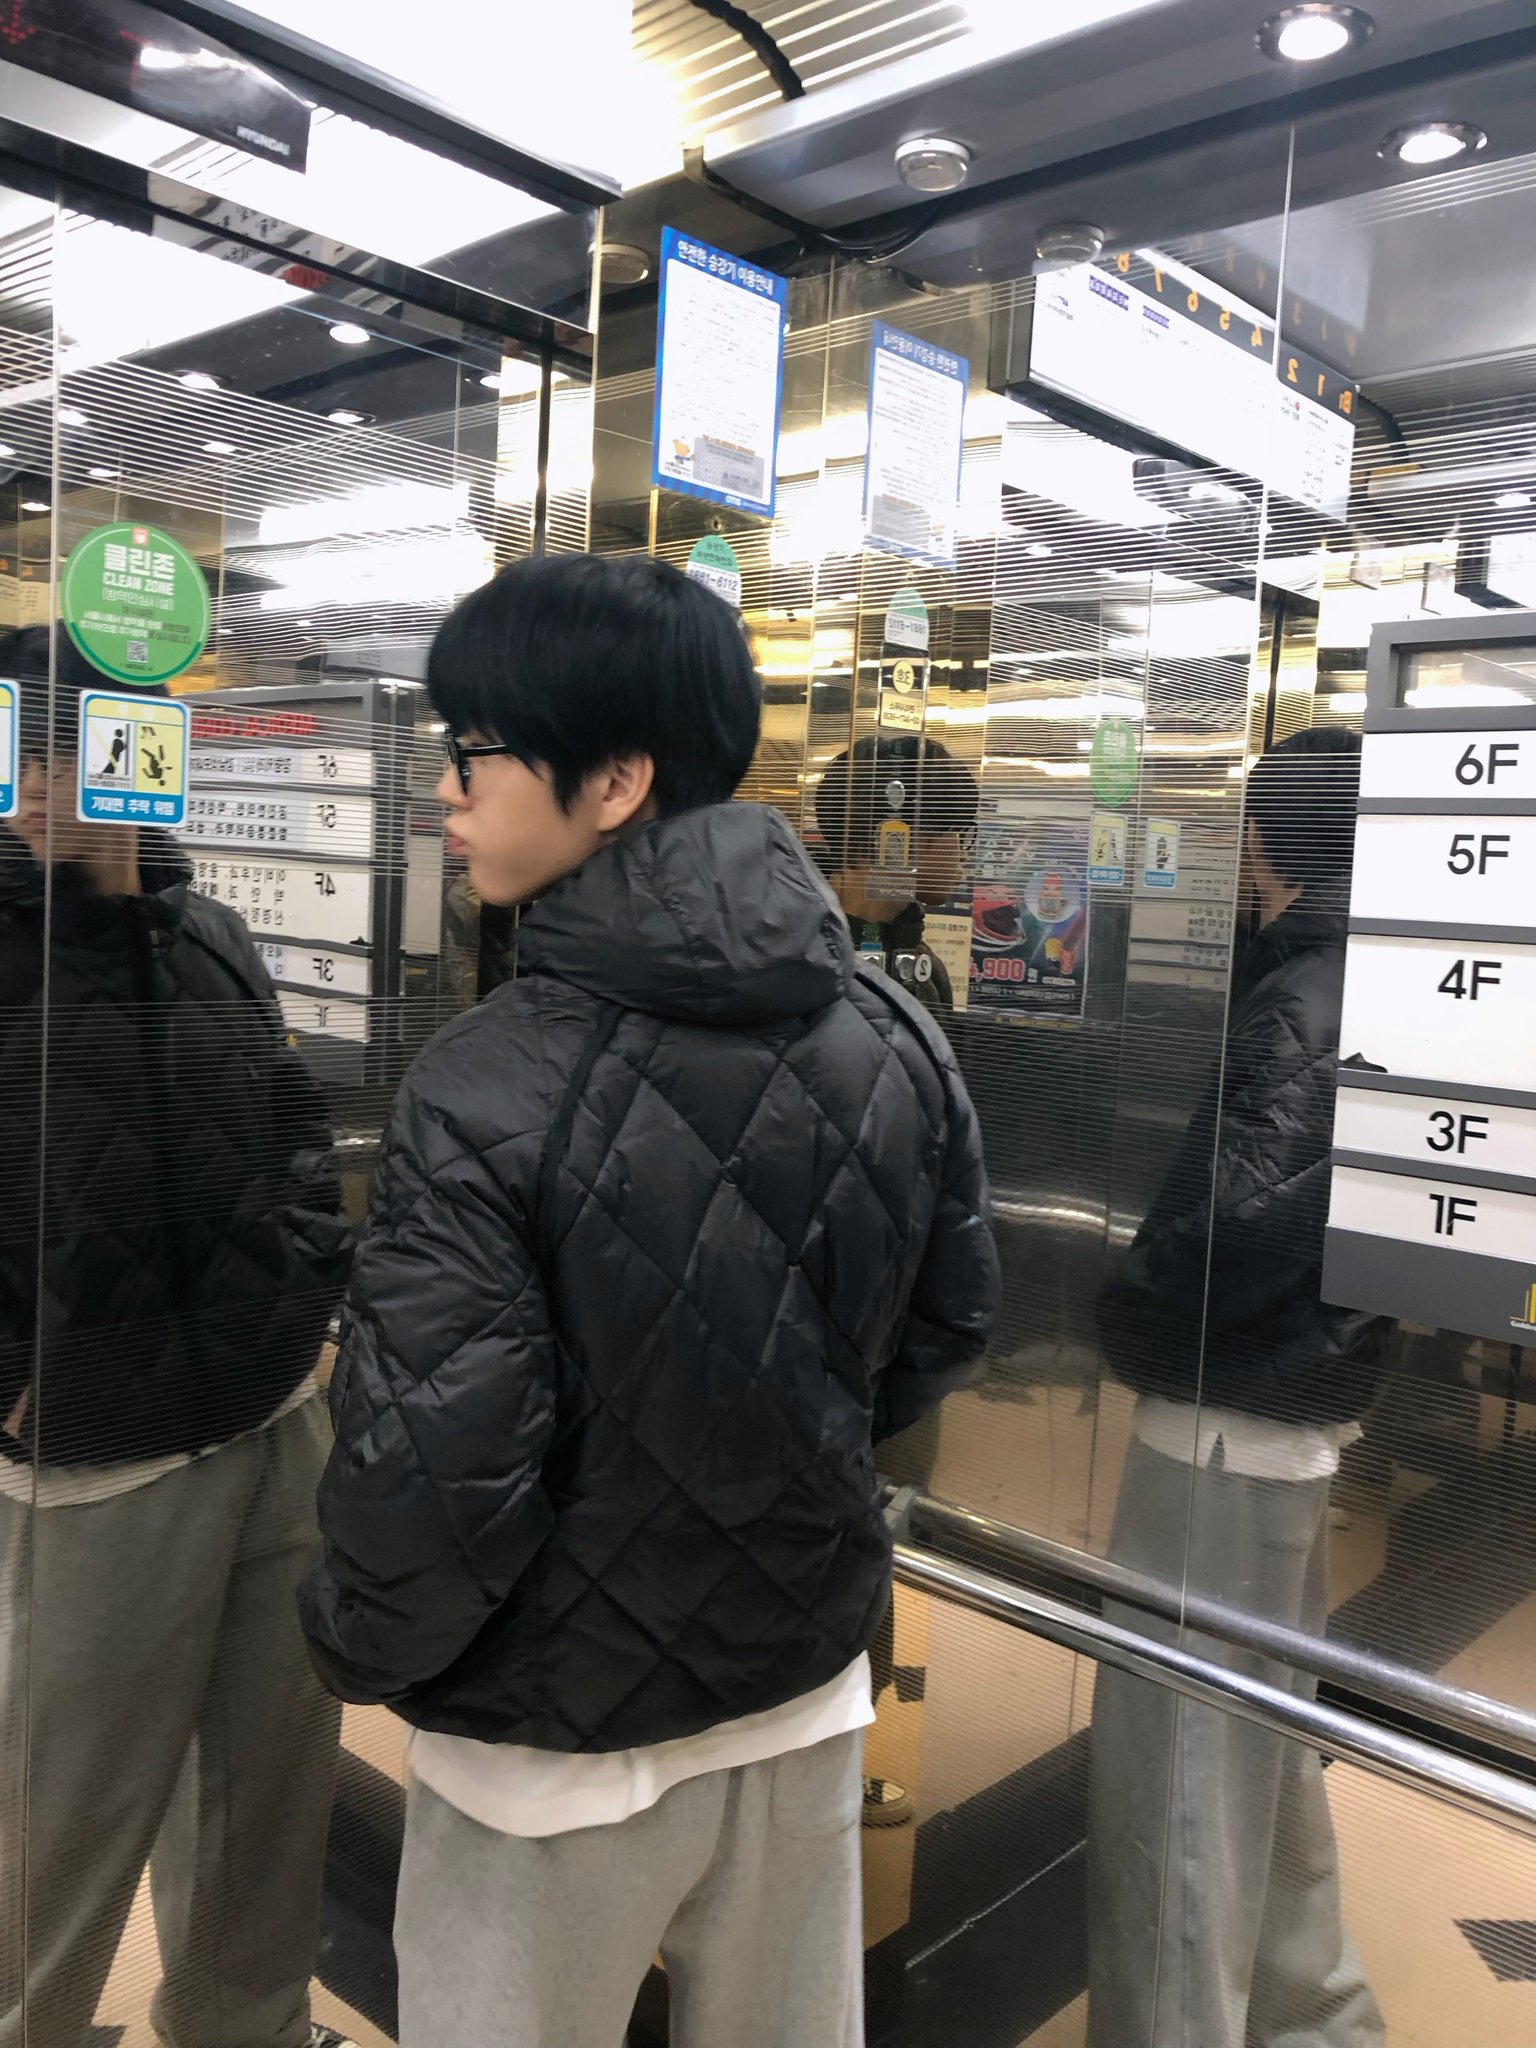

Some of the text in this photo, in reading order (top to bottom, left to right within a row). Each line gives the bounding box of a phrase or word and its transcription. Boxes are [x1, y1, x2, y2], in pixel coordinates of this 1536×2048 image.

[236, 125, 290, 156] HYUNDAI
[677, 240, 774, 296] 안전한 승강기 이용안내
[104, 543, 175, 580] 클린존
[103, 571, 175, 596] CLEAN ZONE
[1455, 743, 1519, 786] 6F
[127, 799, 150, 814] 추락
[153, 800, 175, 816] 위험
[1447, 834, 1510, 875] 5F
[1437, 959, 1502, 1000] 4F
[1426, 1110, 1489, 1154] 3F
[1429, 1193, 1478, 1236] 1F
